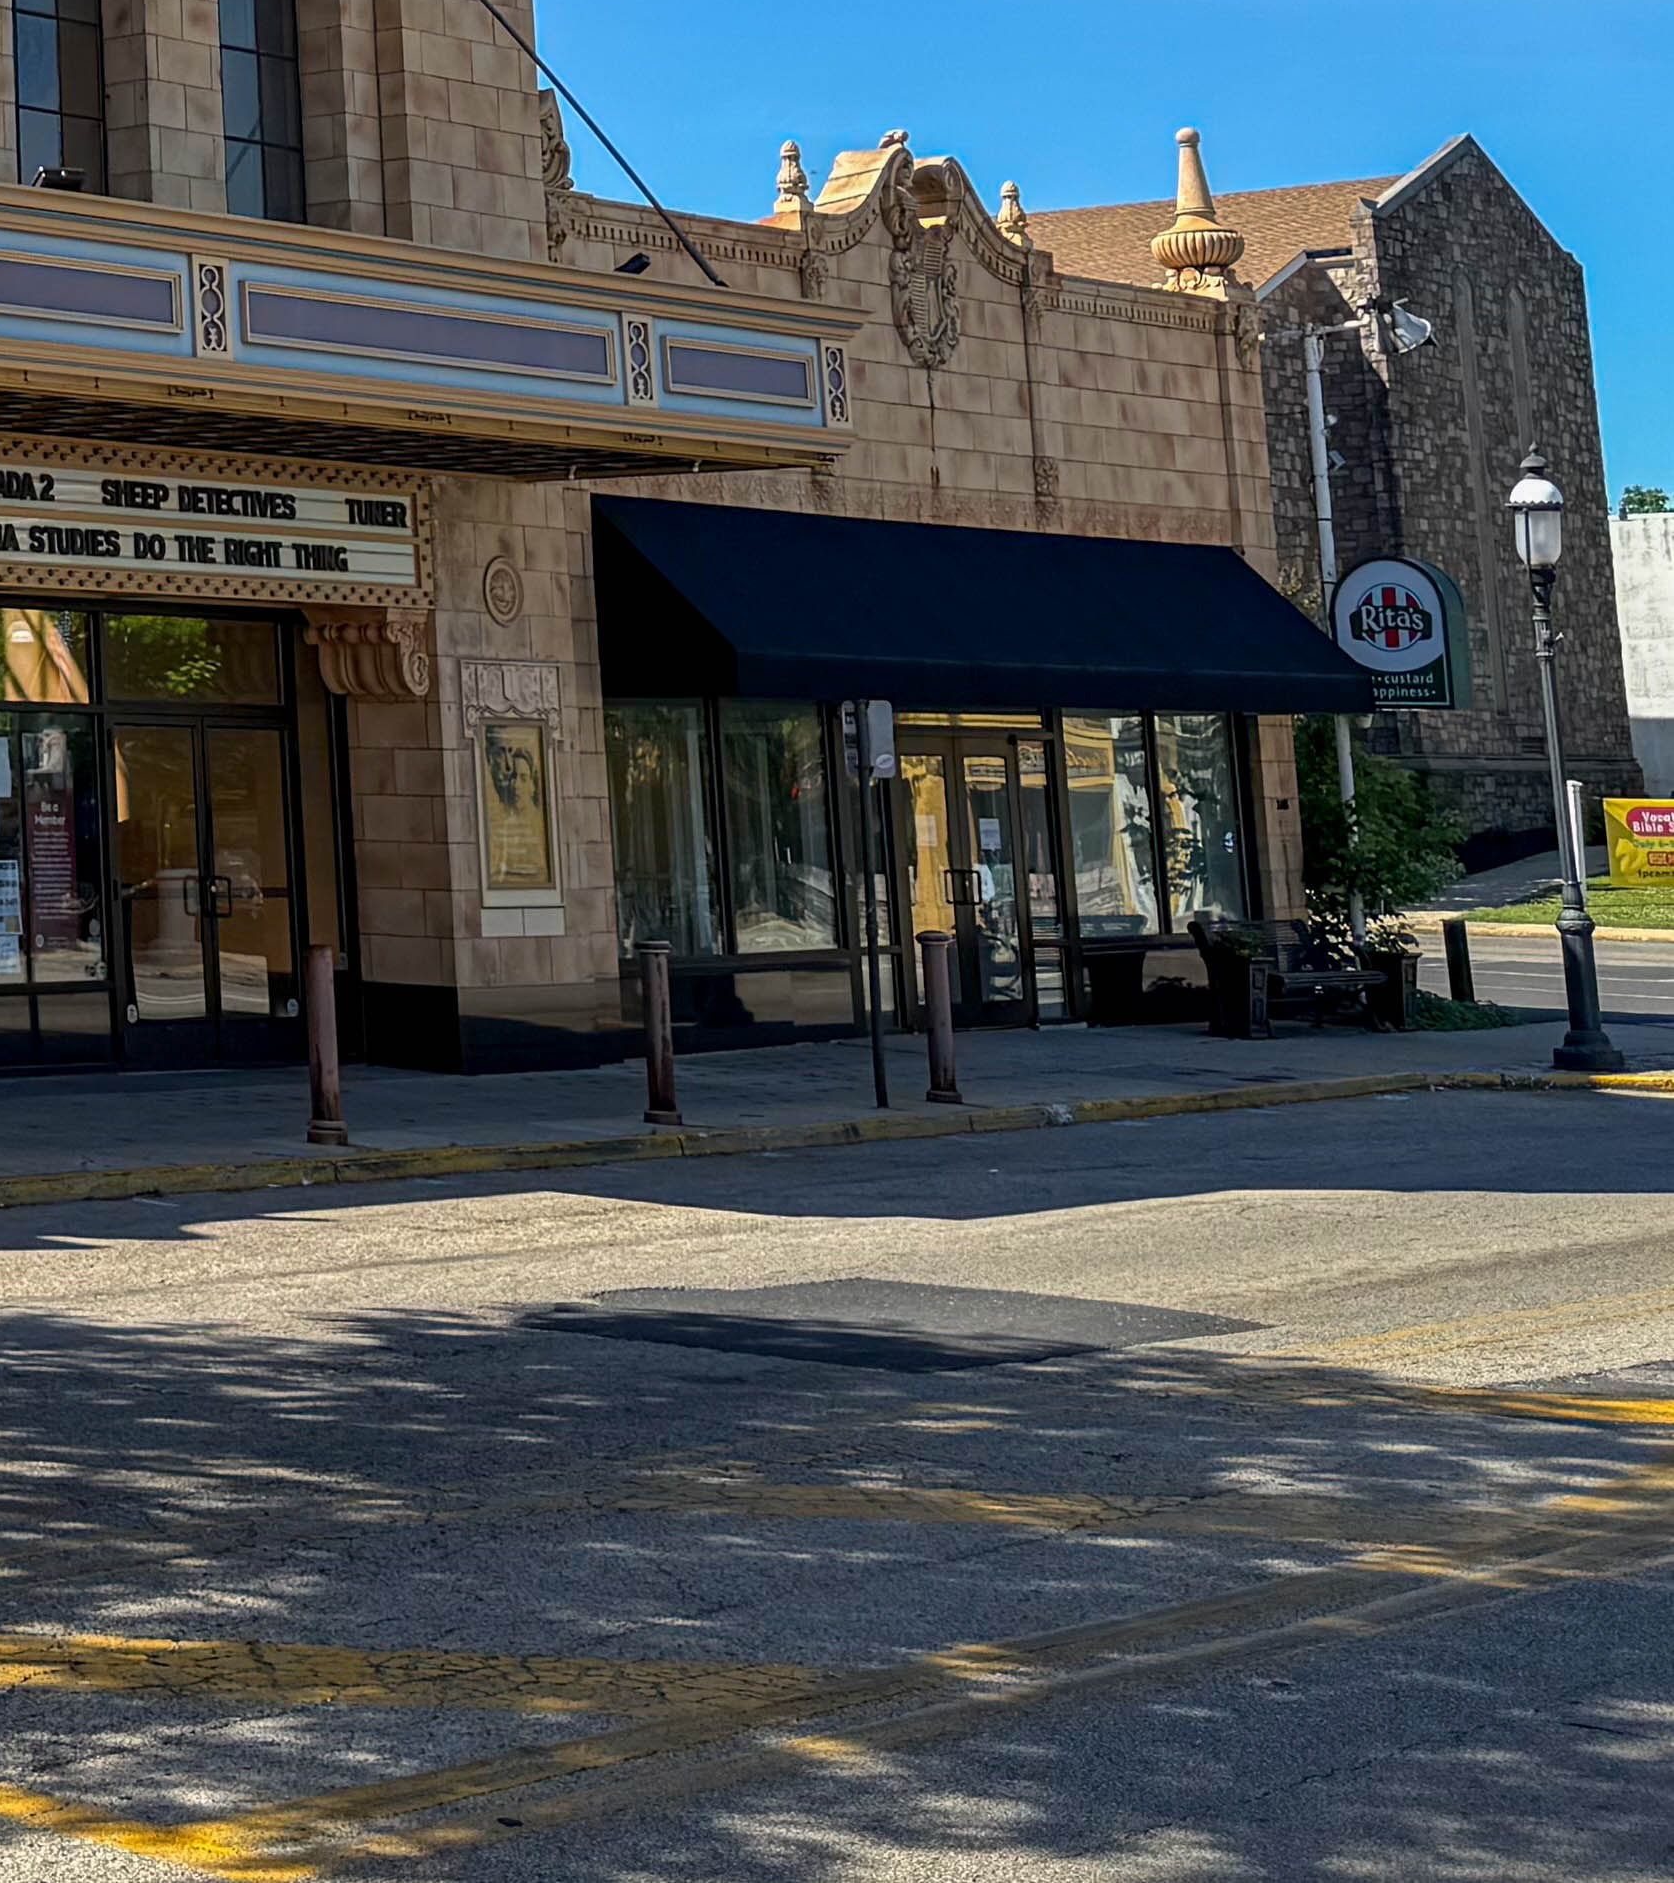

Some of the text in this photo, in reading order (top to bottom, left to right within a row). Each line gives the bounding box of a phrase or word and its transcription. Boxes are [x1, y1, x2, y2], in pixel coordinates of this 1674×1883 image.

[39, 474, 55, 501] 2
[101, 479, 169, 510] SHEEP
[178, 485, 296, 520] DETECTIVES
[345, 498, 407, 528] TUNER
[29, 526, 120, 557] STUDIES
[133, 532, 166, 560] DO
[174, 534, 216, 564] THE
[224, 538, 282, 568] RIGHT
[292, 543, 349, 572] THING
[1361, 604, 1424, 632] Rita's
[1384, 672, 1433, 684] custard
